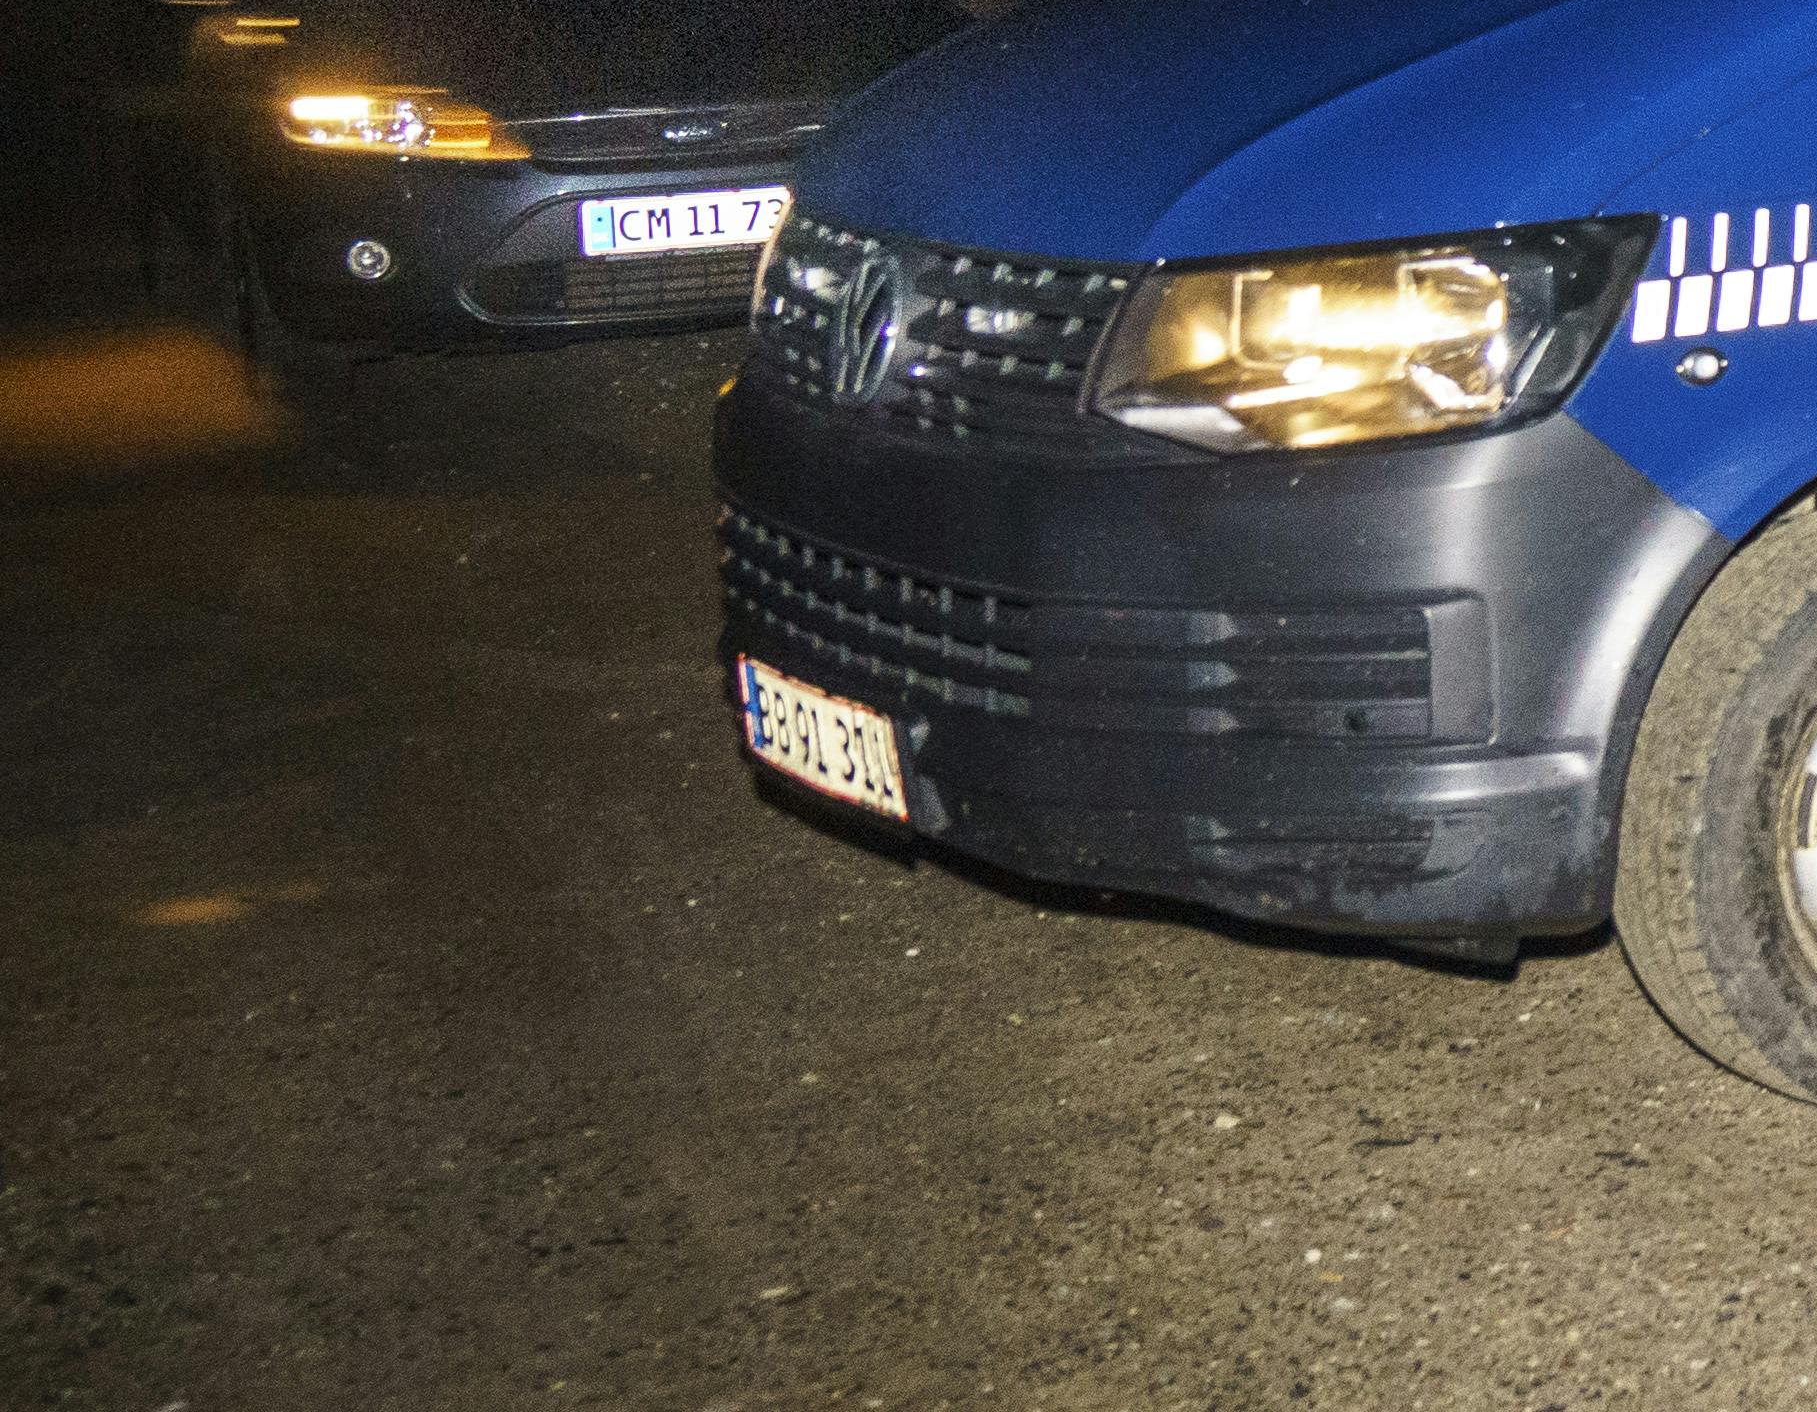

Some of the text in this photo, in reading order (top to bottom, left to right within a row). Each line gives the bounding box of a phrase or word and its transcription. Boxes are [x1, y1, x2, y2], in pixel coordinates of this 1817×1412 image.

[619, 208, 671, 241] CM
[688, 204, 725, 236] 11
[796, 701, 827, 775] 91
